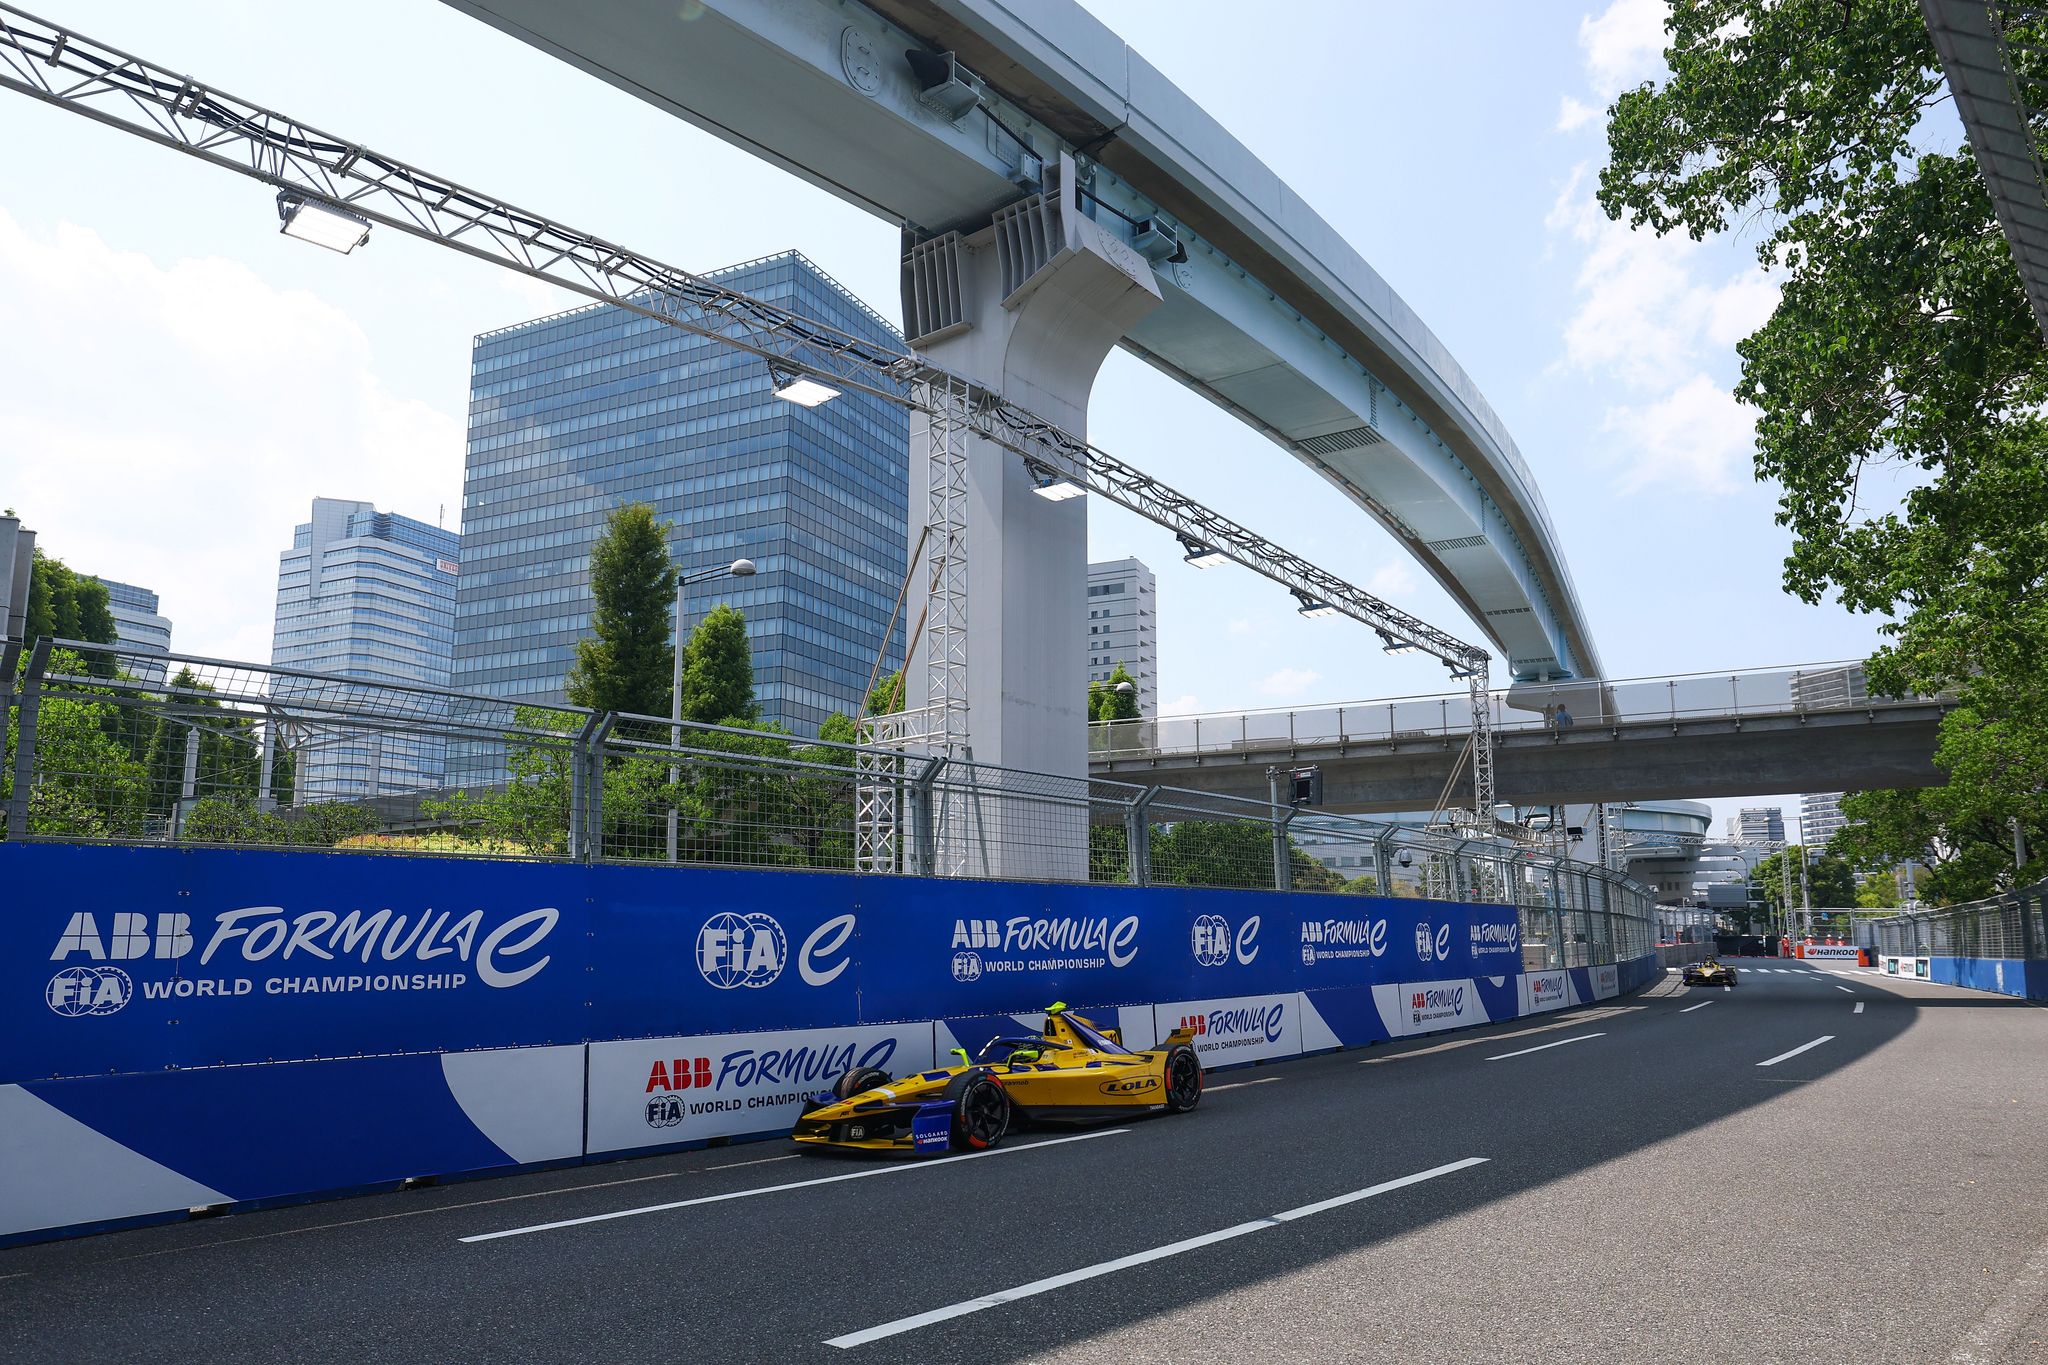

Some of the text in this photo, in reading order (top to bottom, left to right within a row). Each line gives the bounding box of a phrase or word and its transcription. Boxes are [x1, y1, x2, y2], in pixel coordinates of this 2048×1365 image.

[50, 912, 194, 960] ABB
[200, 906, 484, 966] FORMULA
[951, 919, 1001, 949] ABB
[1003, 916, 1108, 953] FORMULA
[1301, 921, 1323, 943] ABB
[1323, 919, 1370, 945] FORMULA
[1481, 923, 1509, 943] FORMULA
[1316, 950, 1335, 959] WORLD
[1335, 949, 1370, 959] CHAMPIONSHIP
[985, 960, 1025, 972] WORLD
[1028, 958, 1106, 972] CHAMPIONSHIP
[143, 979, 253, 999] WORLD
[265, 973, 467, 994] CHAMPIONSHIP
[1412, 992, 1425, 1009] ABB
[1425, 988, 1455, 1009] FORMULA
[1180, 1014, 1206, 1035] ABB
[1208, 1006, 1265, 1038] FORMULA
[1197, 1036, 1264, 1053] WORLD CHAMPIONSHIP
[646, 1057, 712, 1093] ABB
[716, 1042, 857, 1092] FORMULA
[1106, 1079, 1158, 1092] LOLA
[690, 1098, 742, 1115] WORLD
[915, 1130, 948, 1140] SOLGAARD
